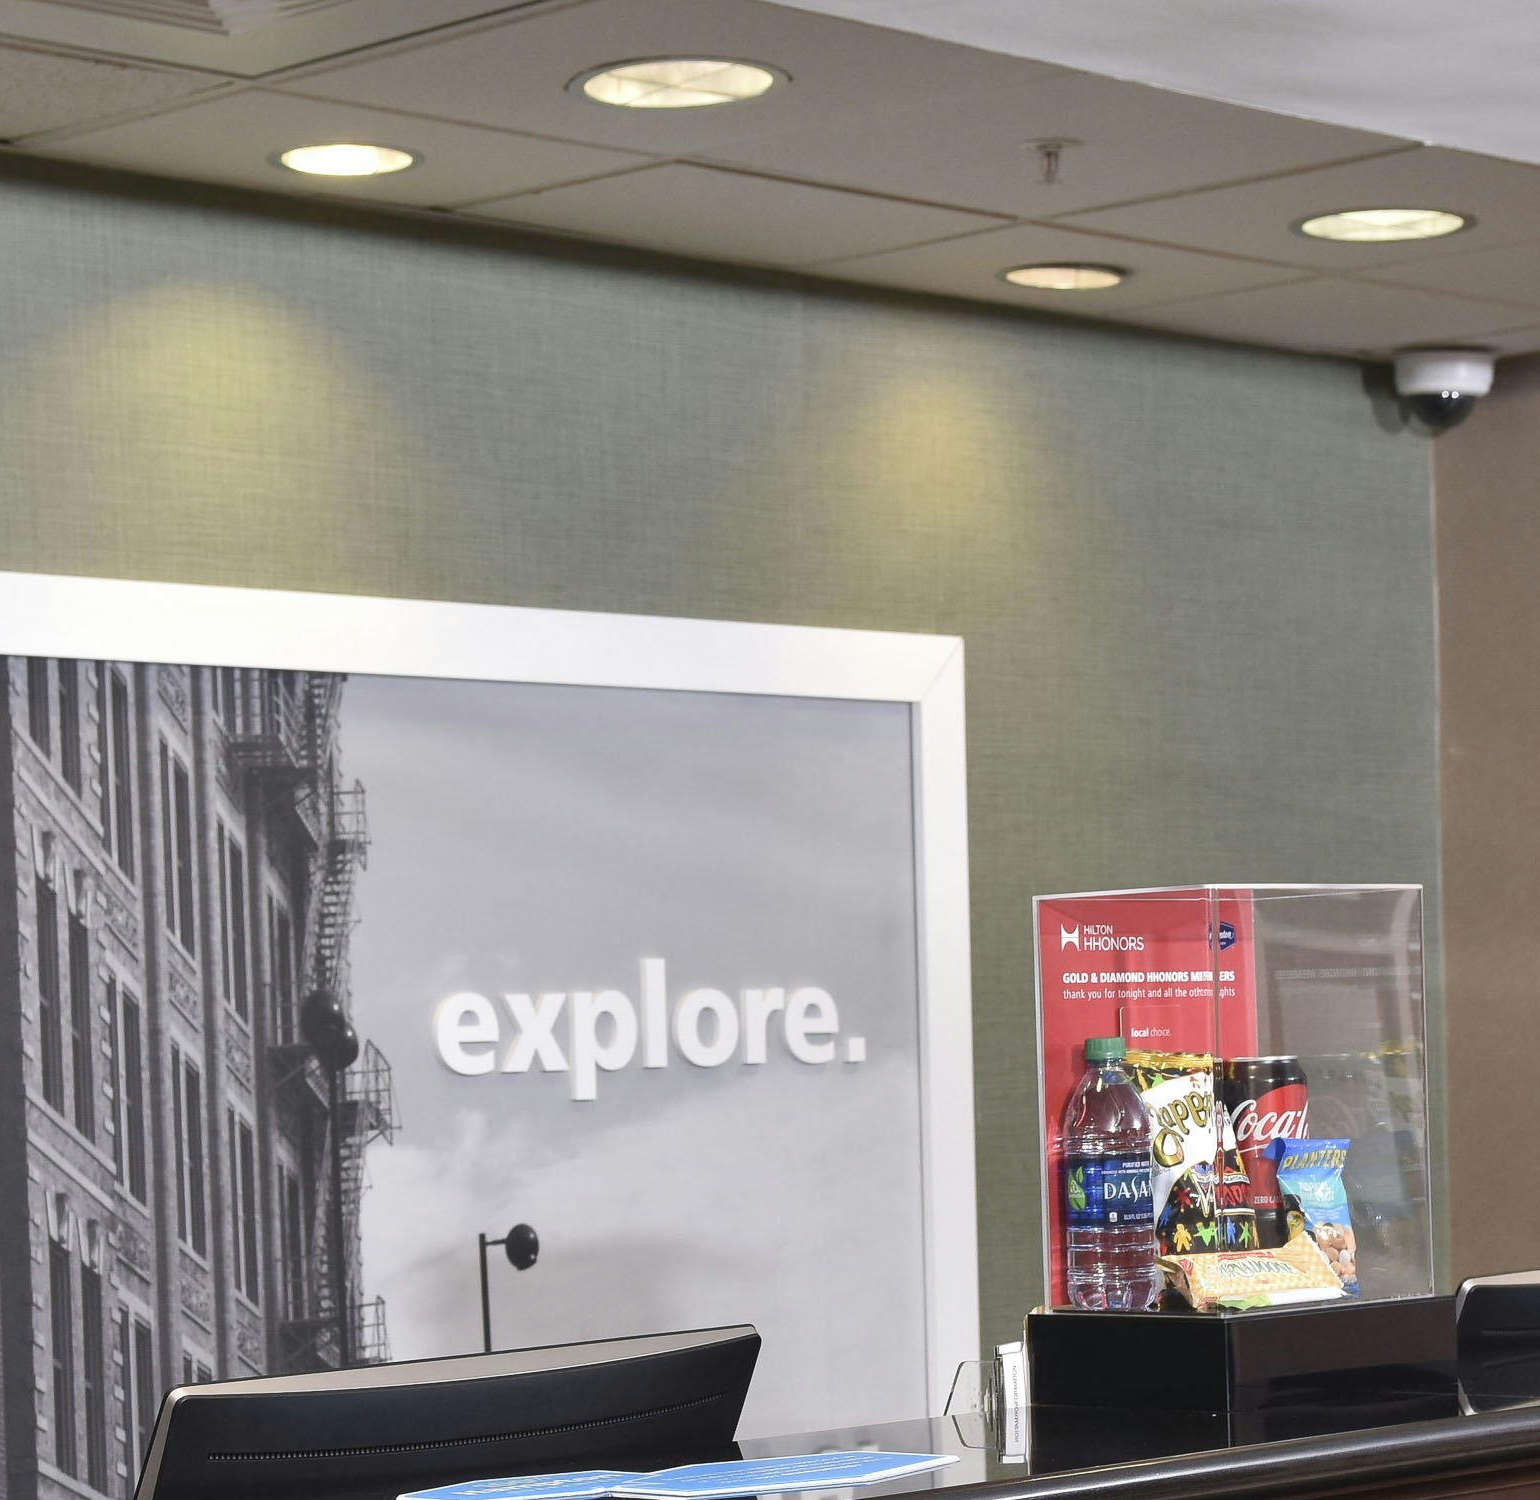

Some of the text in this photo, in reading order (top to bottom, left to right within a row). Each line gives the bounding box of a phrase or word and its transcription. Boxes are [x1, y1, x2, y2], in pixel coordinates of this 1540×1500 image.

[1083, 924, 1113, 935] HILTON
[1083, 936, 1144, 951] HHONORS
[1062, 972, 1089, 984] GOLD
[1090, 972, 1098, 983] &
[1099, 971, 1145, 983] DIAMOND
[1146, 971, 1189, 982] HHONORS
[1063, 988, 1085, 999] thank
[1087, 989, 1102, 1001] you
[1104, 987, 1115, 999] for
[1117, 986, 1146, 1000] tonight
[1147, 987, 1162, 998] and
[1163, 986, 1174, 997] all
[1176, 986, 1188, 998] the
[433, 957, 866, 1101] explore.
[1131, 1027, 1149, 1038] local
[1281, 1149, 1348, 1172] PLANTERS
